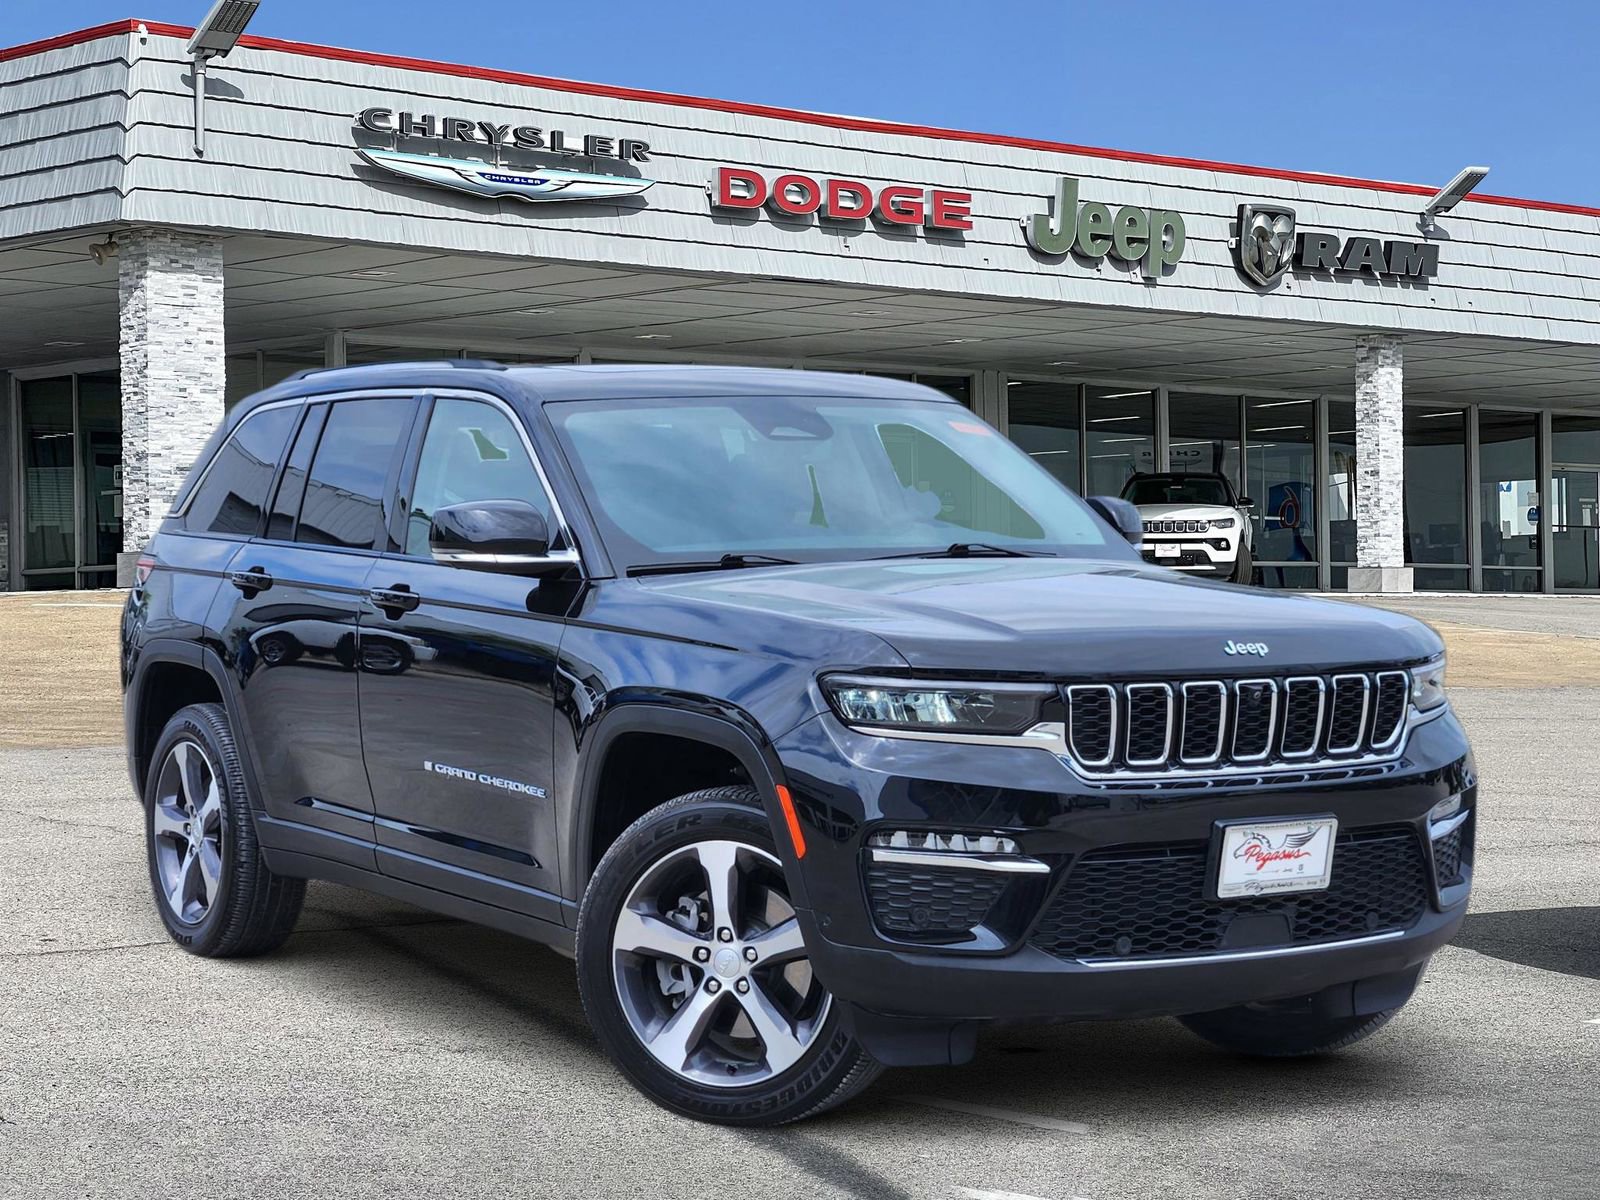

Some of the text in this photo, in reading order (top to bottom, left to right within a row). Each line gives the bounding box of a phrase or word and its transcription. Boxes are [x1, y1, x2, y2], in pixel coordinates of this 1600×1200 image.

[357, 106, 652, 163] CHRYSLER
[484, 174, 541, 185] CHRYSLER
[712, 166, 973, 231] DODGE
[1027, 176, 1186, 279] Jeep
[1298, 232, 1440, 278] RAM
[1224, 640, 1269, 657] Jeep
[434, 763, 547, 799] GRAND CHEROKEE
[1244, 844, 1312, 871] Pegasus
